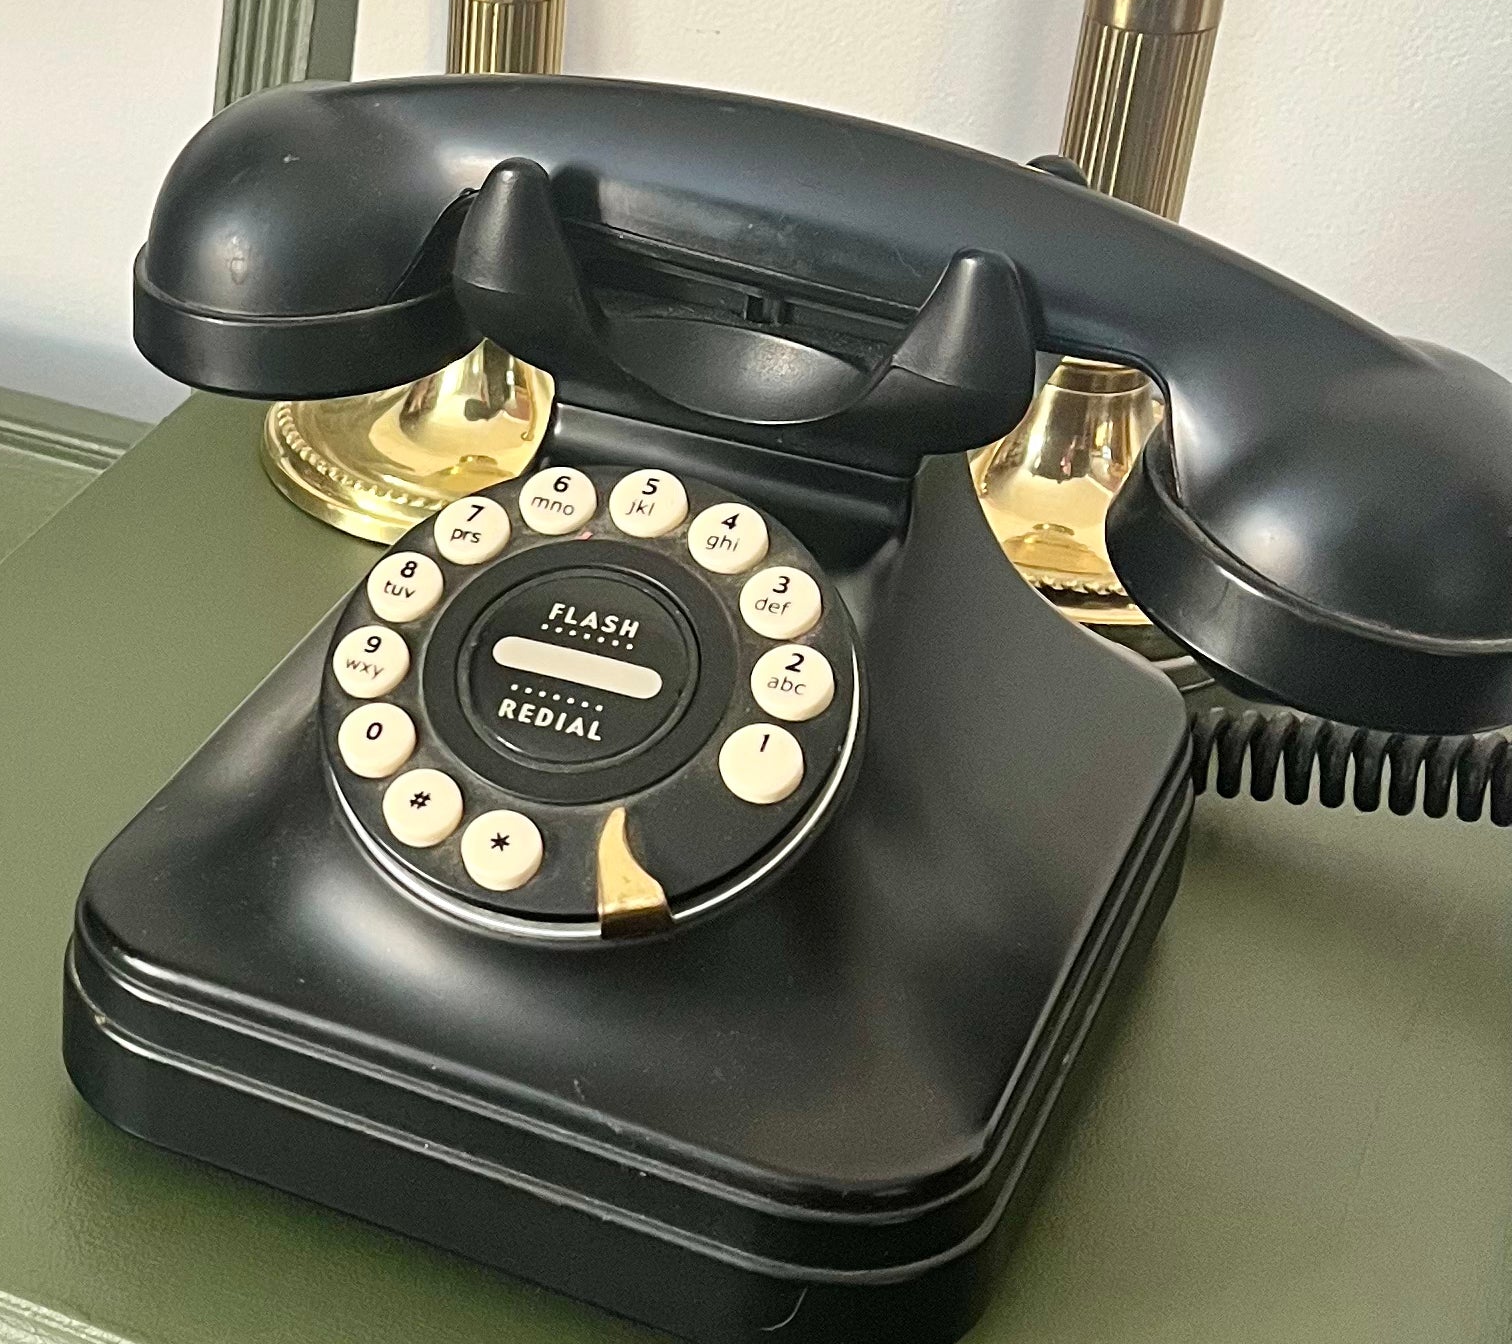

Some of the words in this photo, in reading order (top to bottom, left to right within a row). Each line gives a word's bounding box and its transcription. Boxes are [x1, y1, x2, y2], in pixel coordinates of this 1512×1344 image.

[553, 475, 572, 493] 6
[642, 478, 660, 495] 5
[466, 504, 485, 522] 7
[530, 496, 575, 516] mno
[625, 499, 656, 516] jkl
[721, 513, 740, 530] 4
[450, 528, 482, 544] prs
[705, 535, 740, 552] ghi
[400, 560, 418, 578] 8
[384, 579, 416, 598] tuv
[772, 576, 790, 594] 3
[754, 597, 792, 616] def
[548, 602, 640, 639] FLASH
[364, 635, 382, 653] 9
[346, 658, 385, 680] wxy
[785, 653, 805, 673] 2
[767, 676, 807, 695] abc
[498, 698, 603, 742] REDIAL
[366, 722, 383, 740] 0
[759, 734, 771, 753] 1
